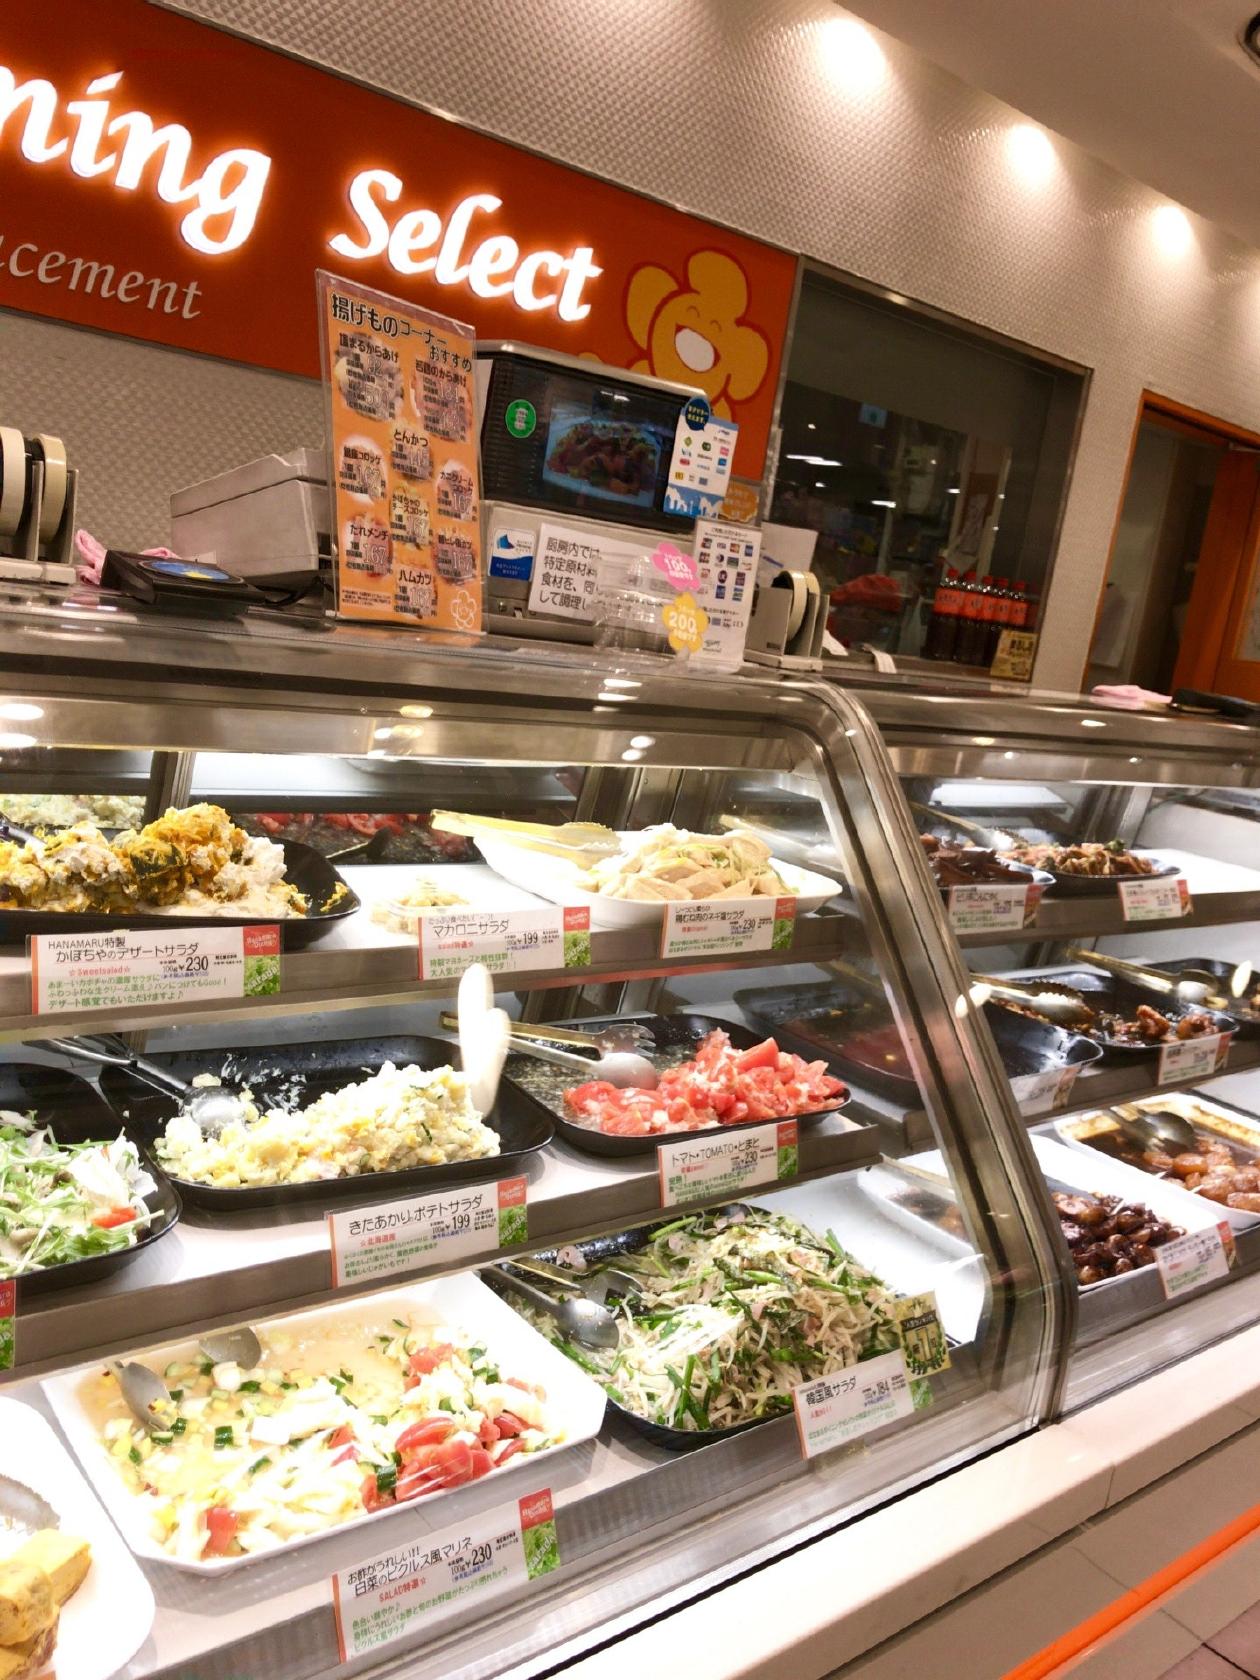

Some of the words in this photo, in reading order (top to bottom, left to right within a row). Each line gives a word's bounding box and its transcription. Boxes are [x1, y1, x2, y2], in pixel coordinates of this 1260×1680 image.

[328, 169, 603, 322] Select
[332, 293, 447, 346] 揚げものコーナー
[429, 345, 472, 372] おすすめ
[394, 429, 428, 447] とんかつ
[350, 524, 389, 540] たれメンチ
[398, 569, 432, 585] ハムカツ
[432, 920, 510, 937] マカロニサラダ
[48, 937, 126, 950] HANAMARU特製
[806, 1376, 857, 1407] 韓国風サラダ
[354, 1536, 473, 1597] 白菜のピクルス風マリネ
